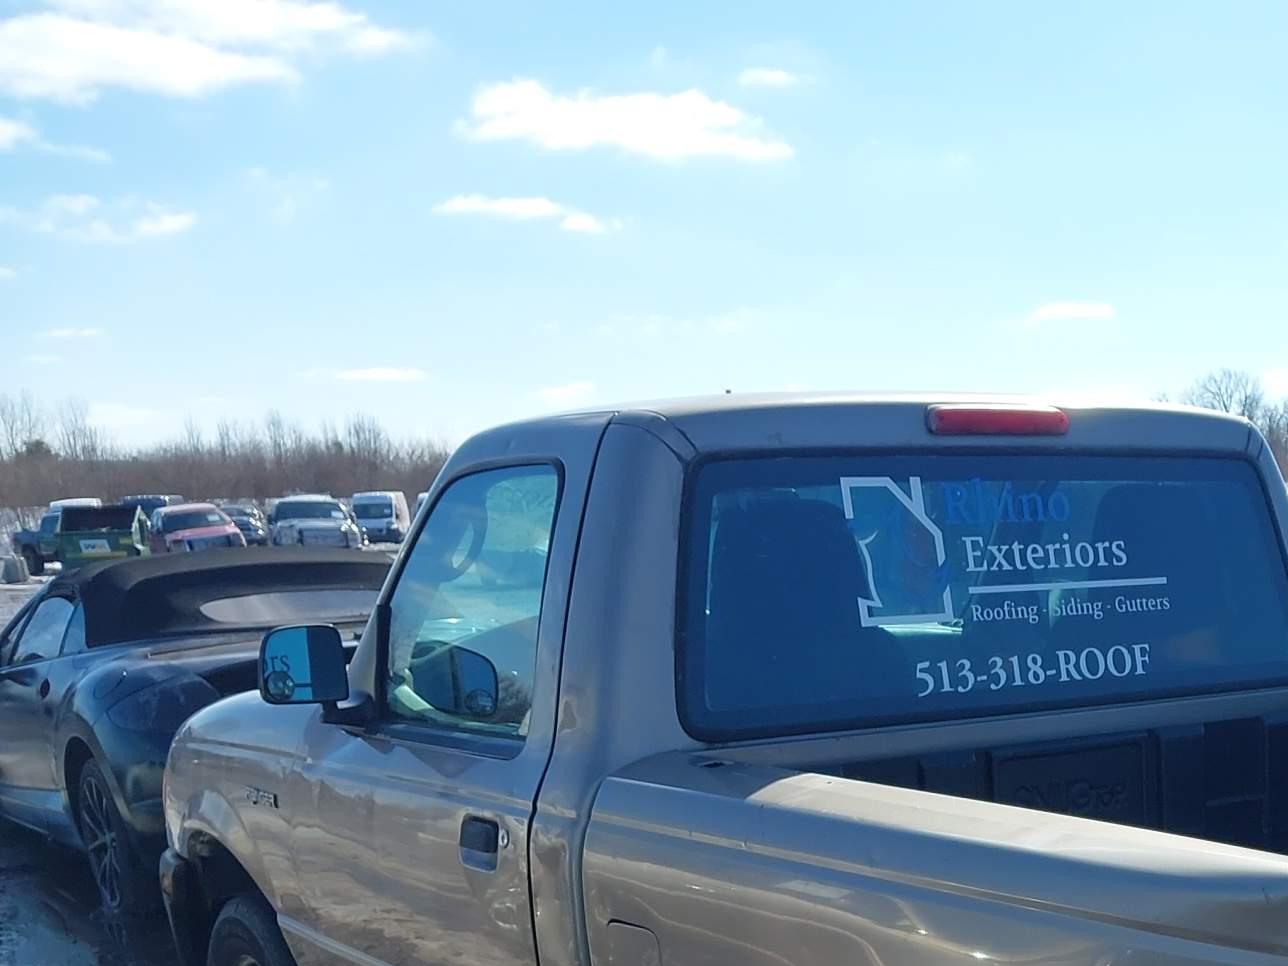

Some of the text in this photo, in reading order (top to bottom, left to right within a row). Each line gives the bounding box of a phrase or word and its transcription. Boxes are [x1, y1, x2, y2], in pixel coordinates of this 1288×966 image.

[945, 478, 1071, 523] Rhino
[961, 532, 1128, 572] Exteriors
[971, 601, 1040, 624] Roofing
[1052, 597, 1103, 619] Siding
[1115, 596, 1170, 613] Gutters
[915, 643, 1150, 697] 513-318-ROOF
